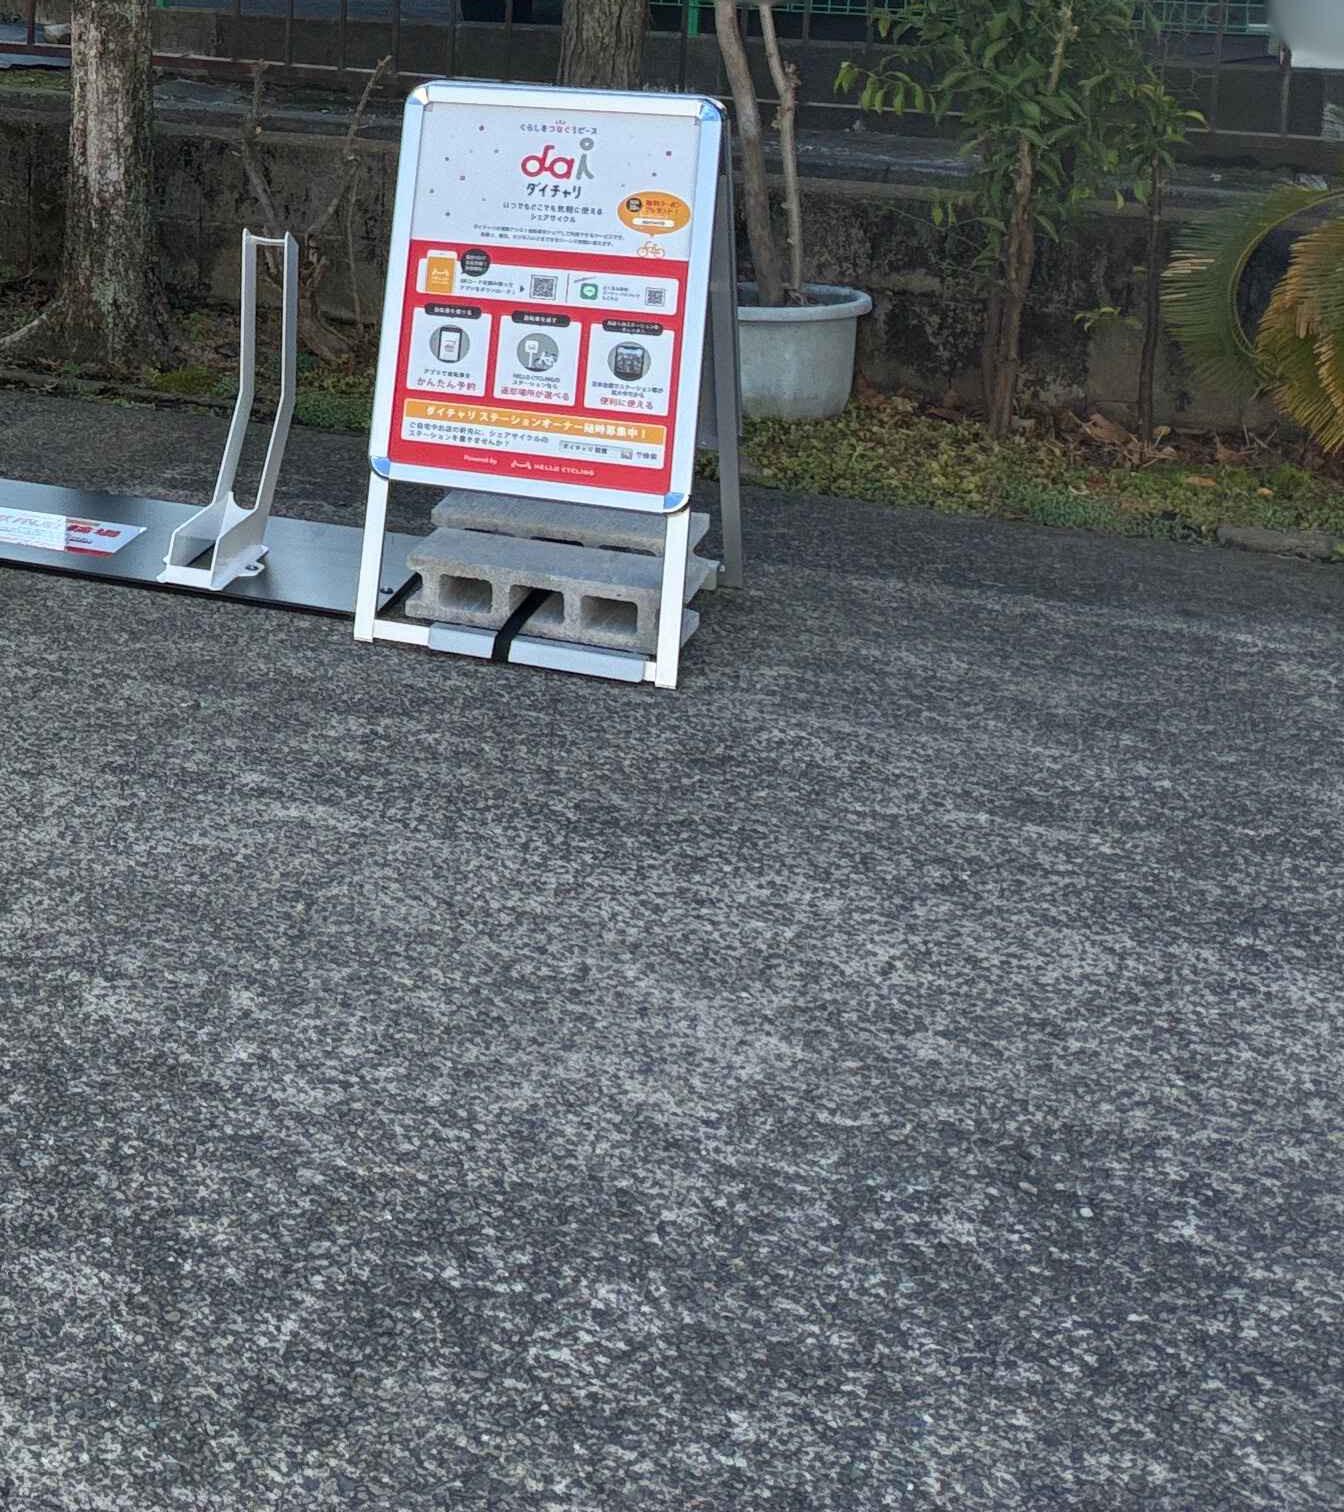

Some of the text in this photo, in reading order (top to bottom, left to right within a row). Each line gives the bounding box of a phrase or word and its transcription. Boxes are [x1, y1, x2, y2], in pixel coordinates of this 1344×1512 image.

[521, 137, 595, 180] dai
[526, 182, 581, 199] ダイチャリ
[503, 201, 603, 216] いつでもどこでも気軽に使える
[530, 213, 576, 223] シェアサイクル
[417, 377, 477, 391] かんたん予約
[600, 396, 653, 410] 便利に使える
[426, 406, 476, 420] ダイチャリ
